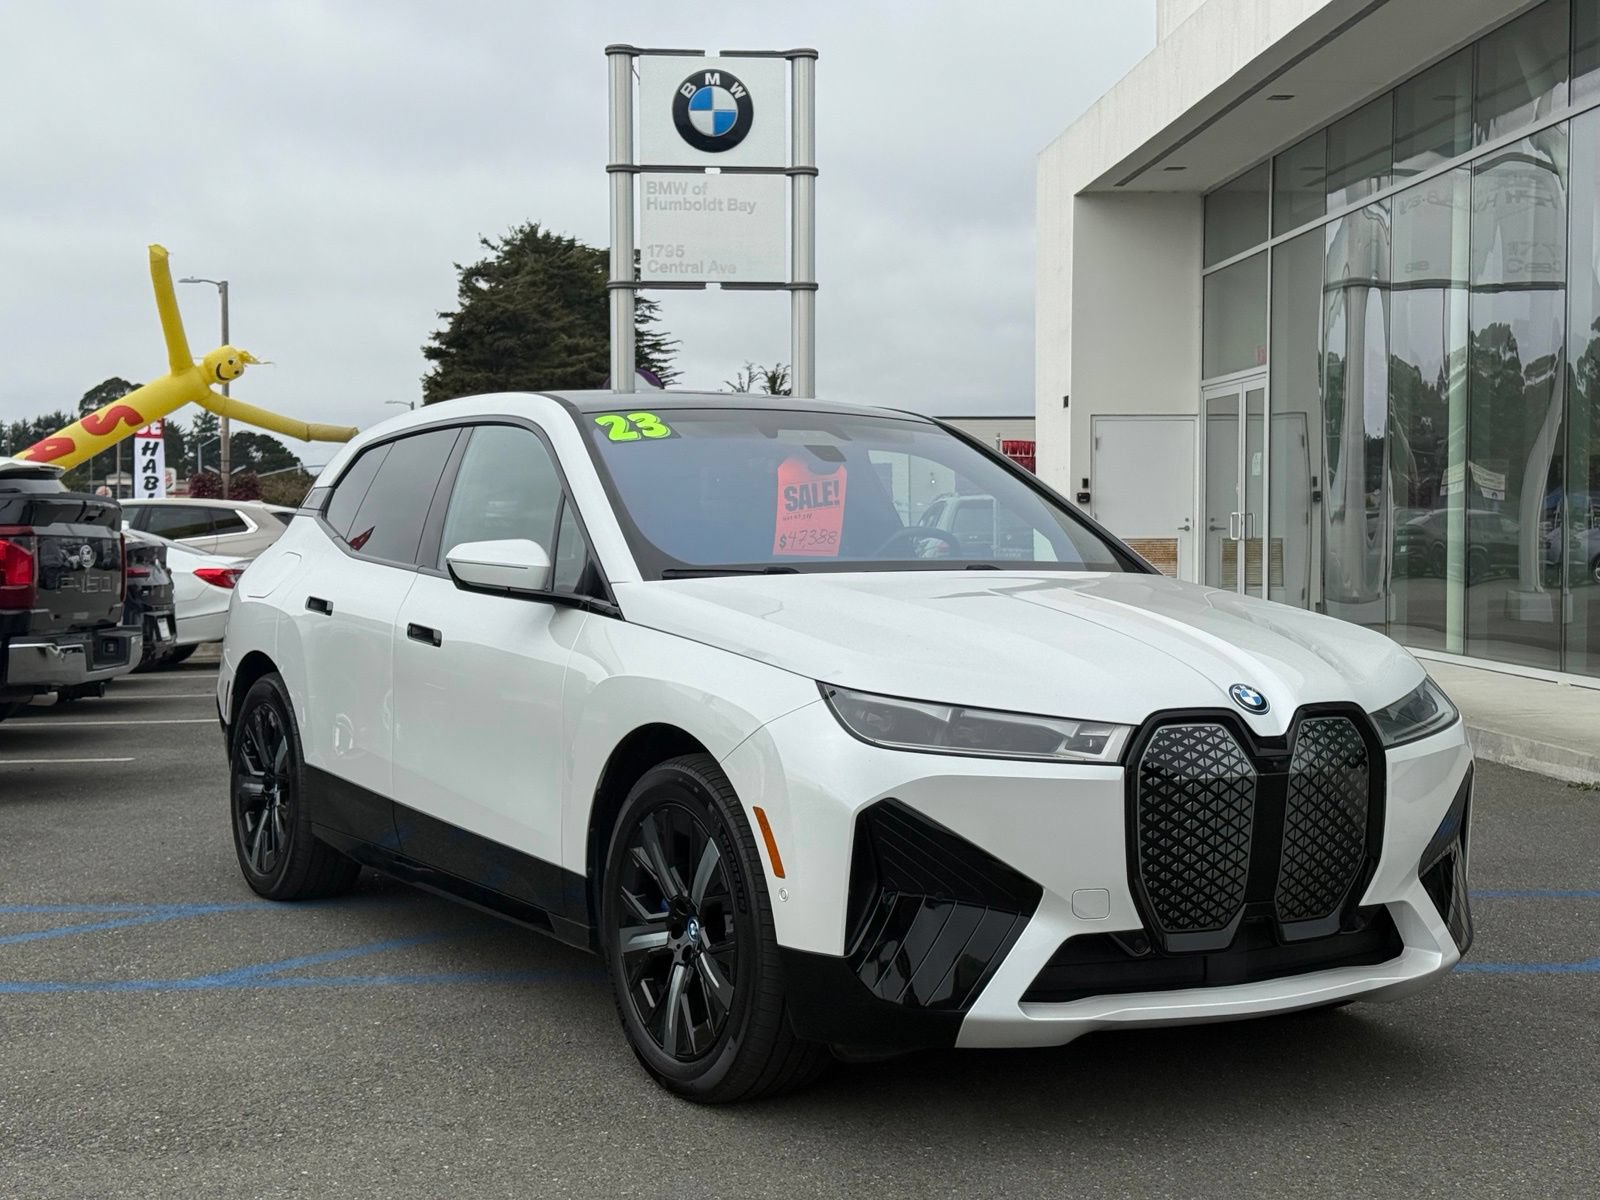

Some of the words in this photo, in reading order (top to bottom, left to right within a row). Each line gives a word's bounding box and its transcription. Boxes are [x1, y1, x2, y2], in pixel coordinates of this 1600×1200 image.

[680, 73, 747, 99] BMW
[646, 181, 688, 195] BMW
[692, 182, 708, 195] of
[646, 197, 724, 211] Humboldt
[728, 198, 757, 214] Bay
[647, 244, 685, 258] 1795
[647, 259, 704, 274] Central
[707, 260, 737, 275] Ave
[594, 412, 671, 441] 23
[784, 480, 840, 512] SALE!
